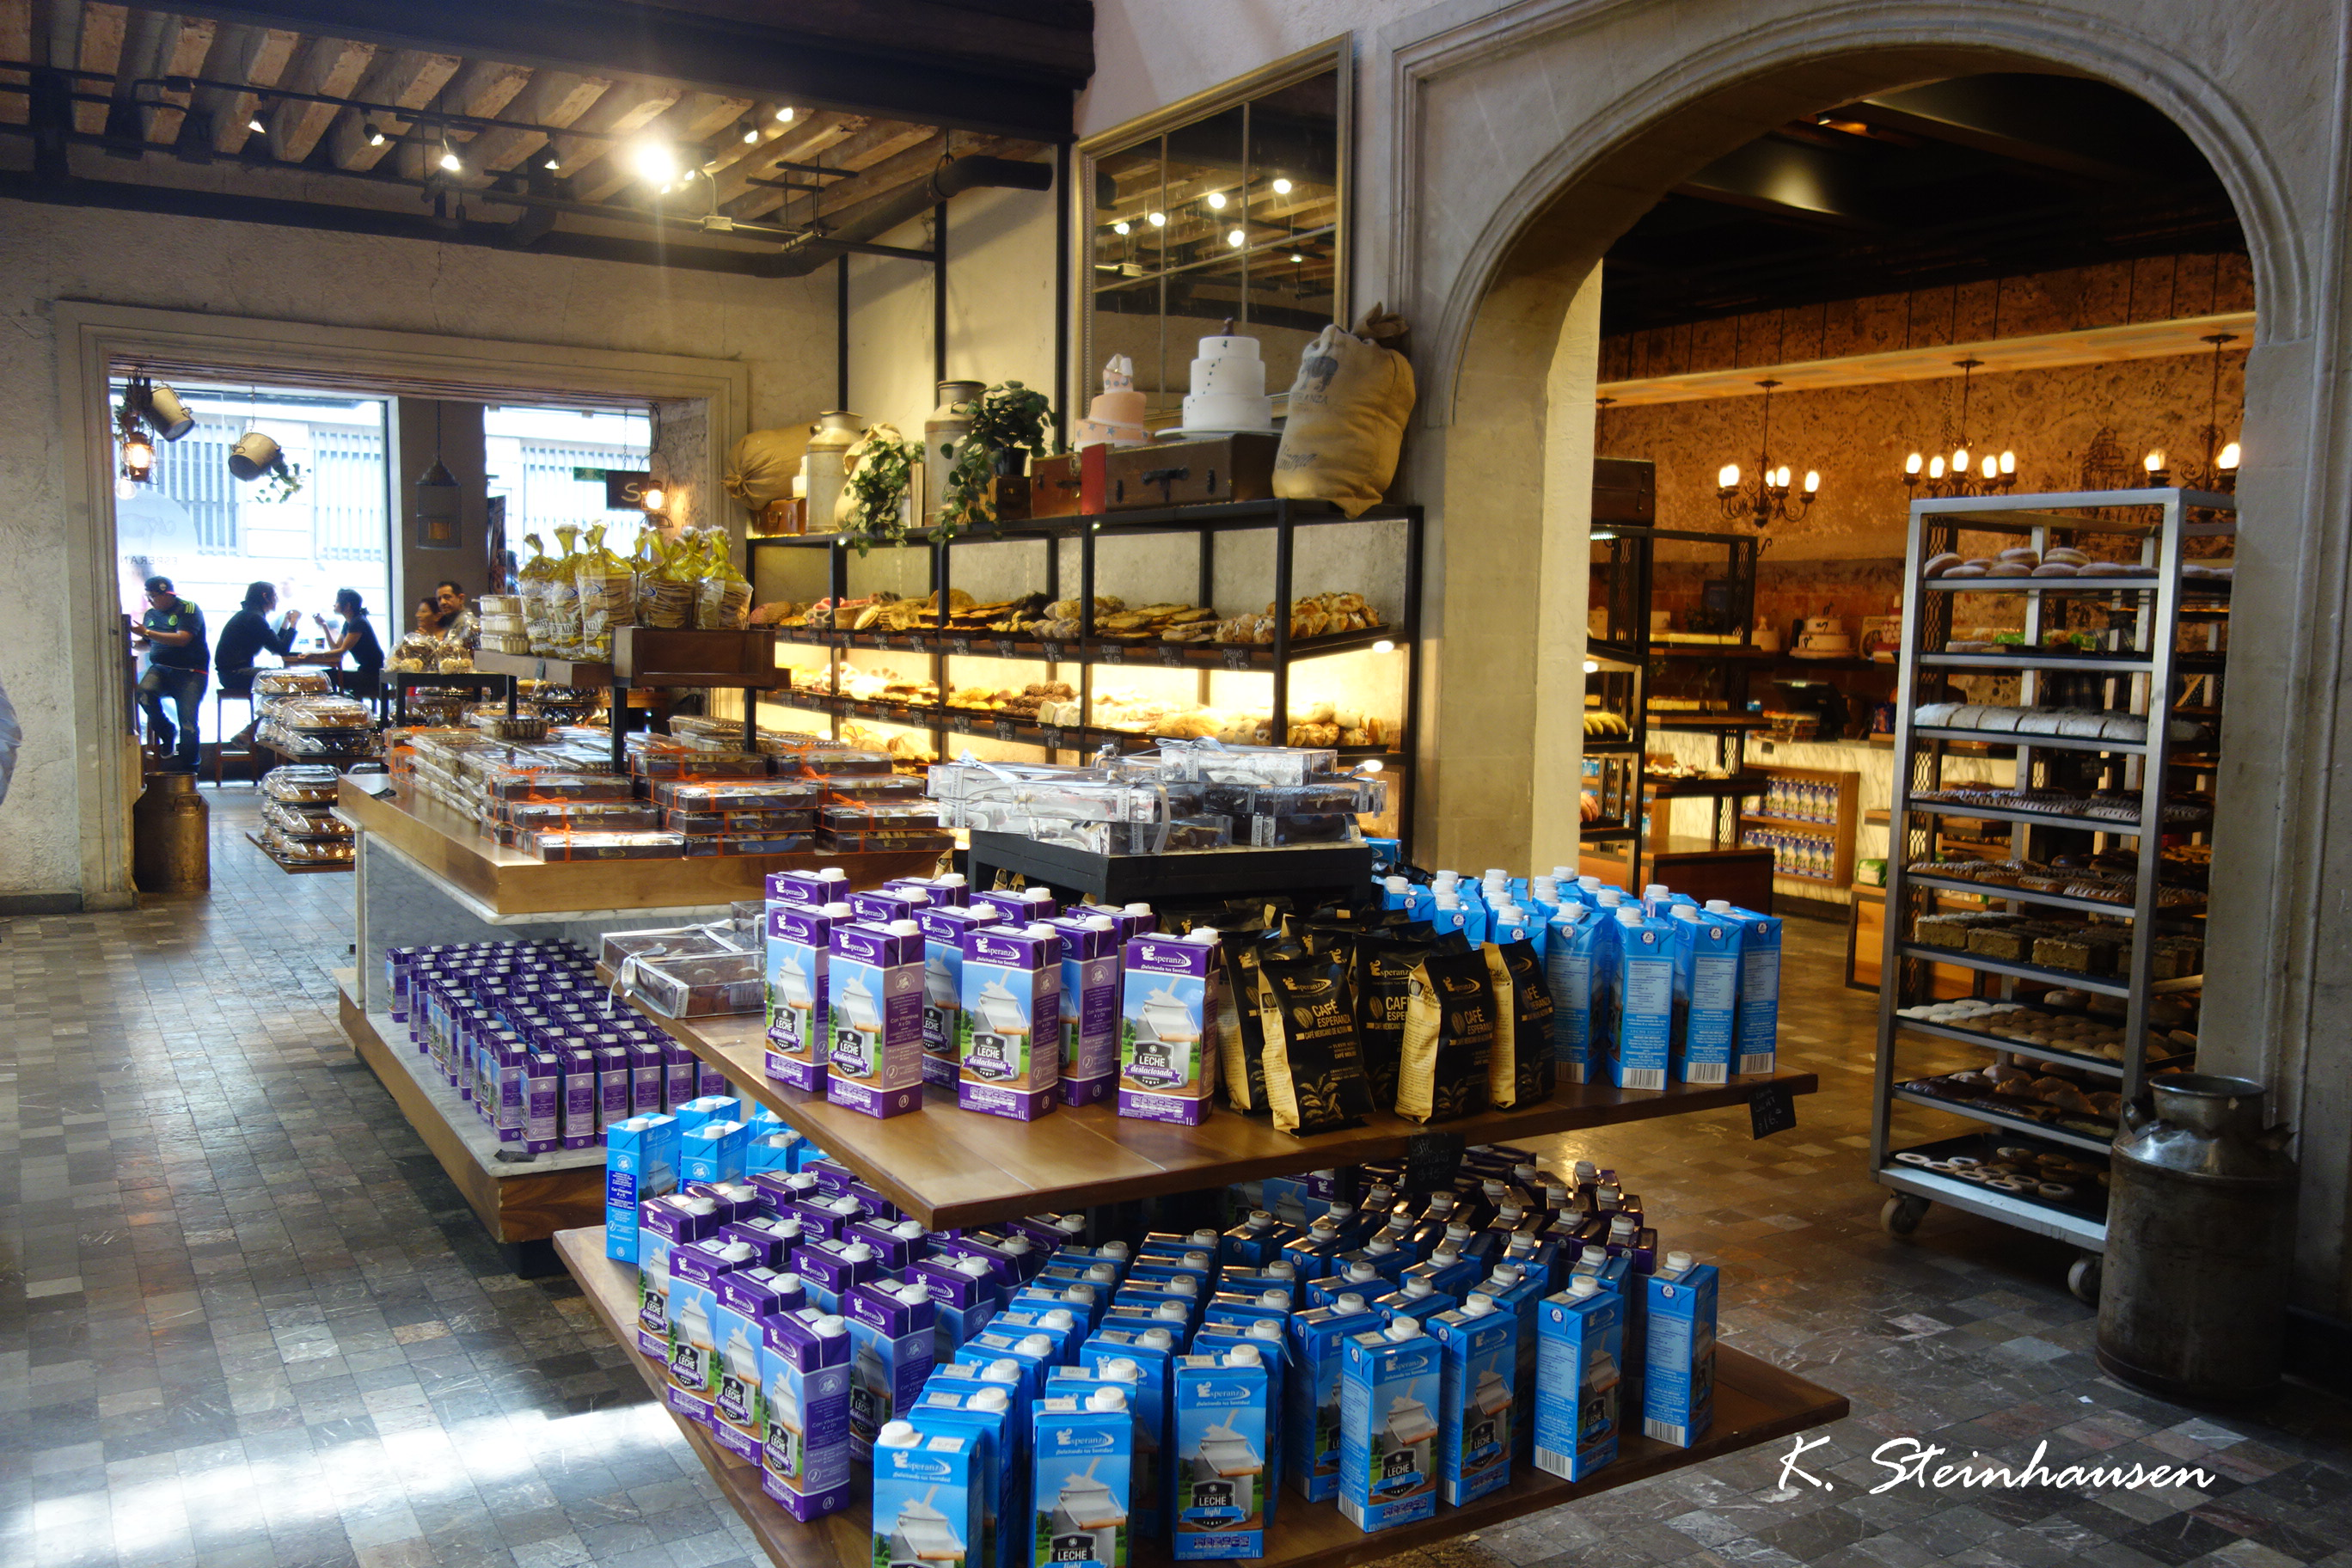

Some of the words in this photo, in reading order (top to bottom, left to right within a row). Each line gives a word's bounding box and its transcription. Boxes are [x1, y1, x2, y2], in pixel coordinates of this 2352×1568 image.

[976, 937, 1017, 958] Esperanza
[1142, 946, 1187, 965] Esperanza
[1369, 960, 1410, 977] Esperanz
[1312, 999, 1339, 1017] CAFÉ
[1465, 1007, 1485, 1023] CAFÉ
[775, 1019, 793, 1032] LECHE
[1317, 1015, 1351, 1028] ESPERANZA
[840, 1042, 859, 1057] LECHE
[977, 1048, 1000, 1059] LECHE
[1139, 1056, 1166, 1067] LECHE
[1130, 1065, 1173, 1078] deslactosada
[646, 1302, 661, 1315] LECHE
[678, 1356, 695, 1369] LECHE
[726, 1387, 741, 1403] LECHE
[1197, 1381, 1246, 1400] Esperanza
[1057, 1428, 1109, 1446] Esperanza
[1474, 1435, 1491, 1449] LECHE
[771, 1436, 785, 1453] LECHE
[891, 1451, 945, 1473] Esperanza
[1387, 1464, 1410, 1476] LECHE
[1199, 1496, 1227, 1506] LECHE
[1204, 1508, 1222, 1516] light
[1057, 1550, 1087, 1561] LECHE
